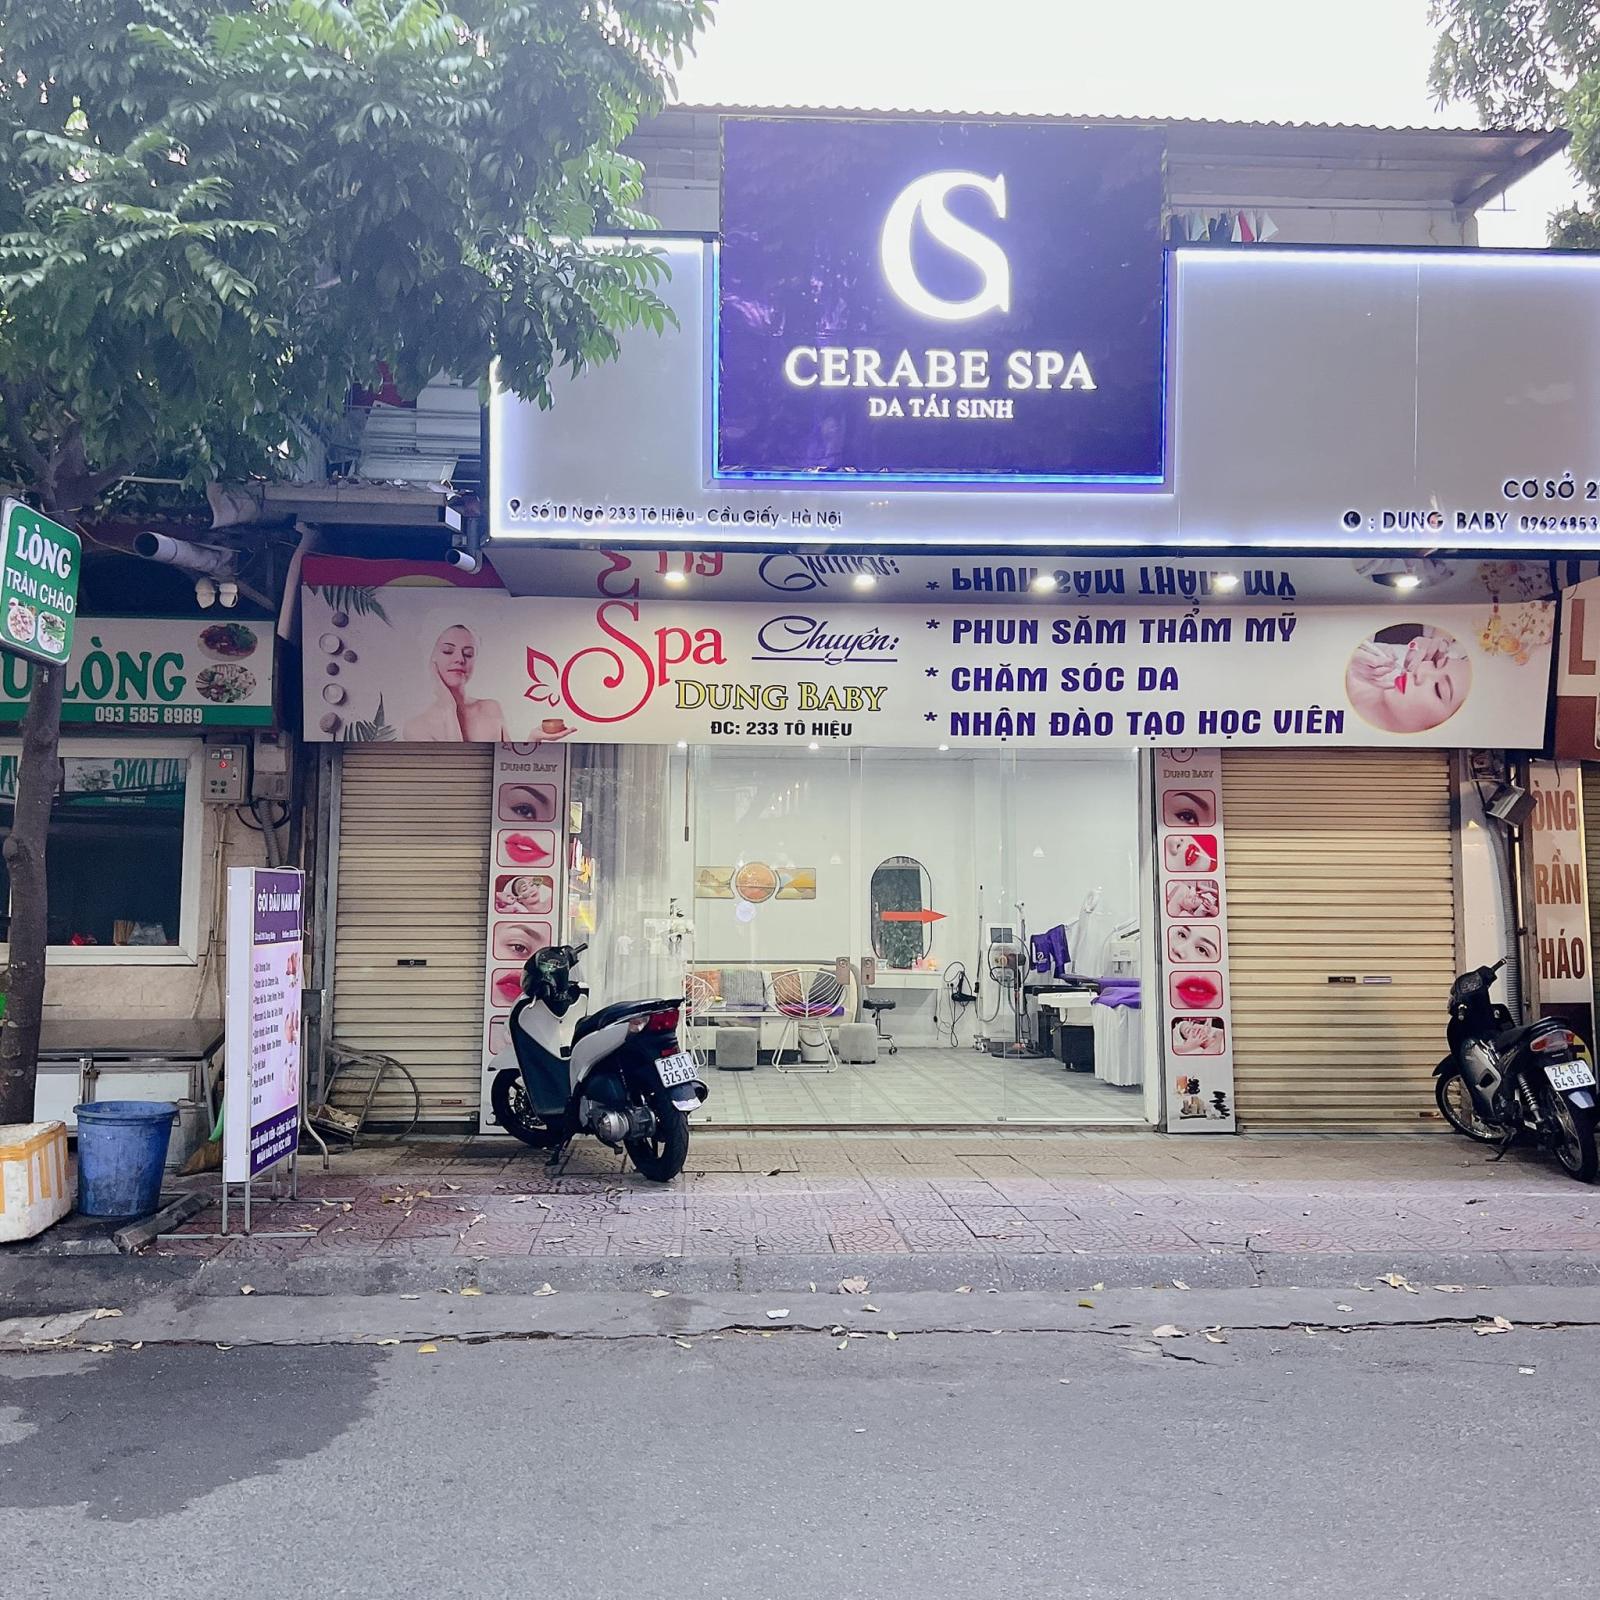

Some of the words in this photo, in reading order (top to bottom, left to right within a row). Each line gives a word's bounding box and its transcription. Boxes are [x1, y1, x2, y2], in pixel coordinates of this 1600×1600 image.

[784, 347, 991, 389] CERABE
[1007, 350, 1098, 390] SPA
[869, 397, 905, 417] DA
[909, 393, 950, 418] TÁI
[956, 399, 1015, 420] SINH
[1503, 478, 1539, 499] CƠ
[1545, 473, 1575, 499] SỞ
[531, 501, 551, 519] Số
[553, 505, 567, 520] 10
[609, 506, 636, 520] 233
[661, 507, 695, 525] Hiệu
[707, 505, 740, 524] Cầu
[743, 505, 780, 526] Giấy
[791, 509, 811, 525] Hà
[817, 509, 842, 529] Nội
[1383, 511, 1444, 530] DUNG
[1456, 511, 1509, 530] BABY
[15, 523, 72, 580] LÒNG
[39, 583, 74, 614] CHÁO
[951, 619, 1039, 645] PHUN
[1051, 615, 1127, 645] SĂM
[1139, 608, 1232, 644] THẨM
[1244, 612, 1297, 643] MỸ
[561, 600, 728, 723] Spa
[951, 662, 1048, 693] CHĂM
[1060, 661, 1125, 693] SÓC
[1137, 667, 1179, 692] DA
[675, 679, 790, 713] DUNG
[797, 679, 888, 713] BABY
[95, 706, 124, 722] 093
[129, 706, 159, 723] 585
[163, 708, 203, 724] 8989
[710, 721, 741, 736] ĐC:
[746, 721, 779, 736] 233
[784, 719, 807, 736] TÔ
[811, 720, 853, 739] HIỆU
[950, 707, 1037, 742] NHẬN
[1048, 706, 1114, 737] ĐÀO
[1126, 711, 1185, 741] TẠO
[1199, 710, 1261, 740] HỌC
[1273, 704, 1345, 735] VIÊN
[1536, 928, 1585, 979] HÁO
